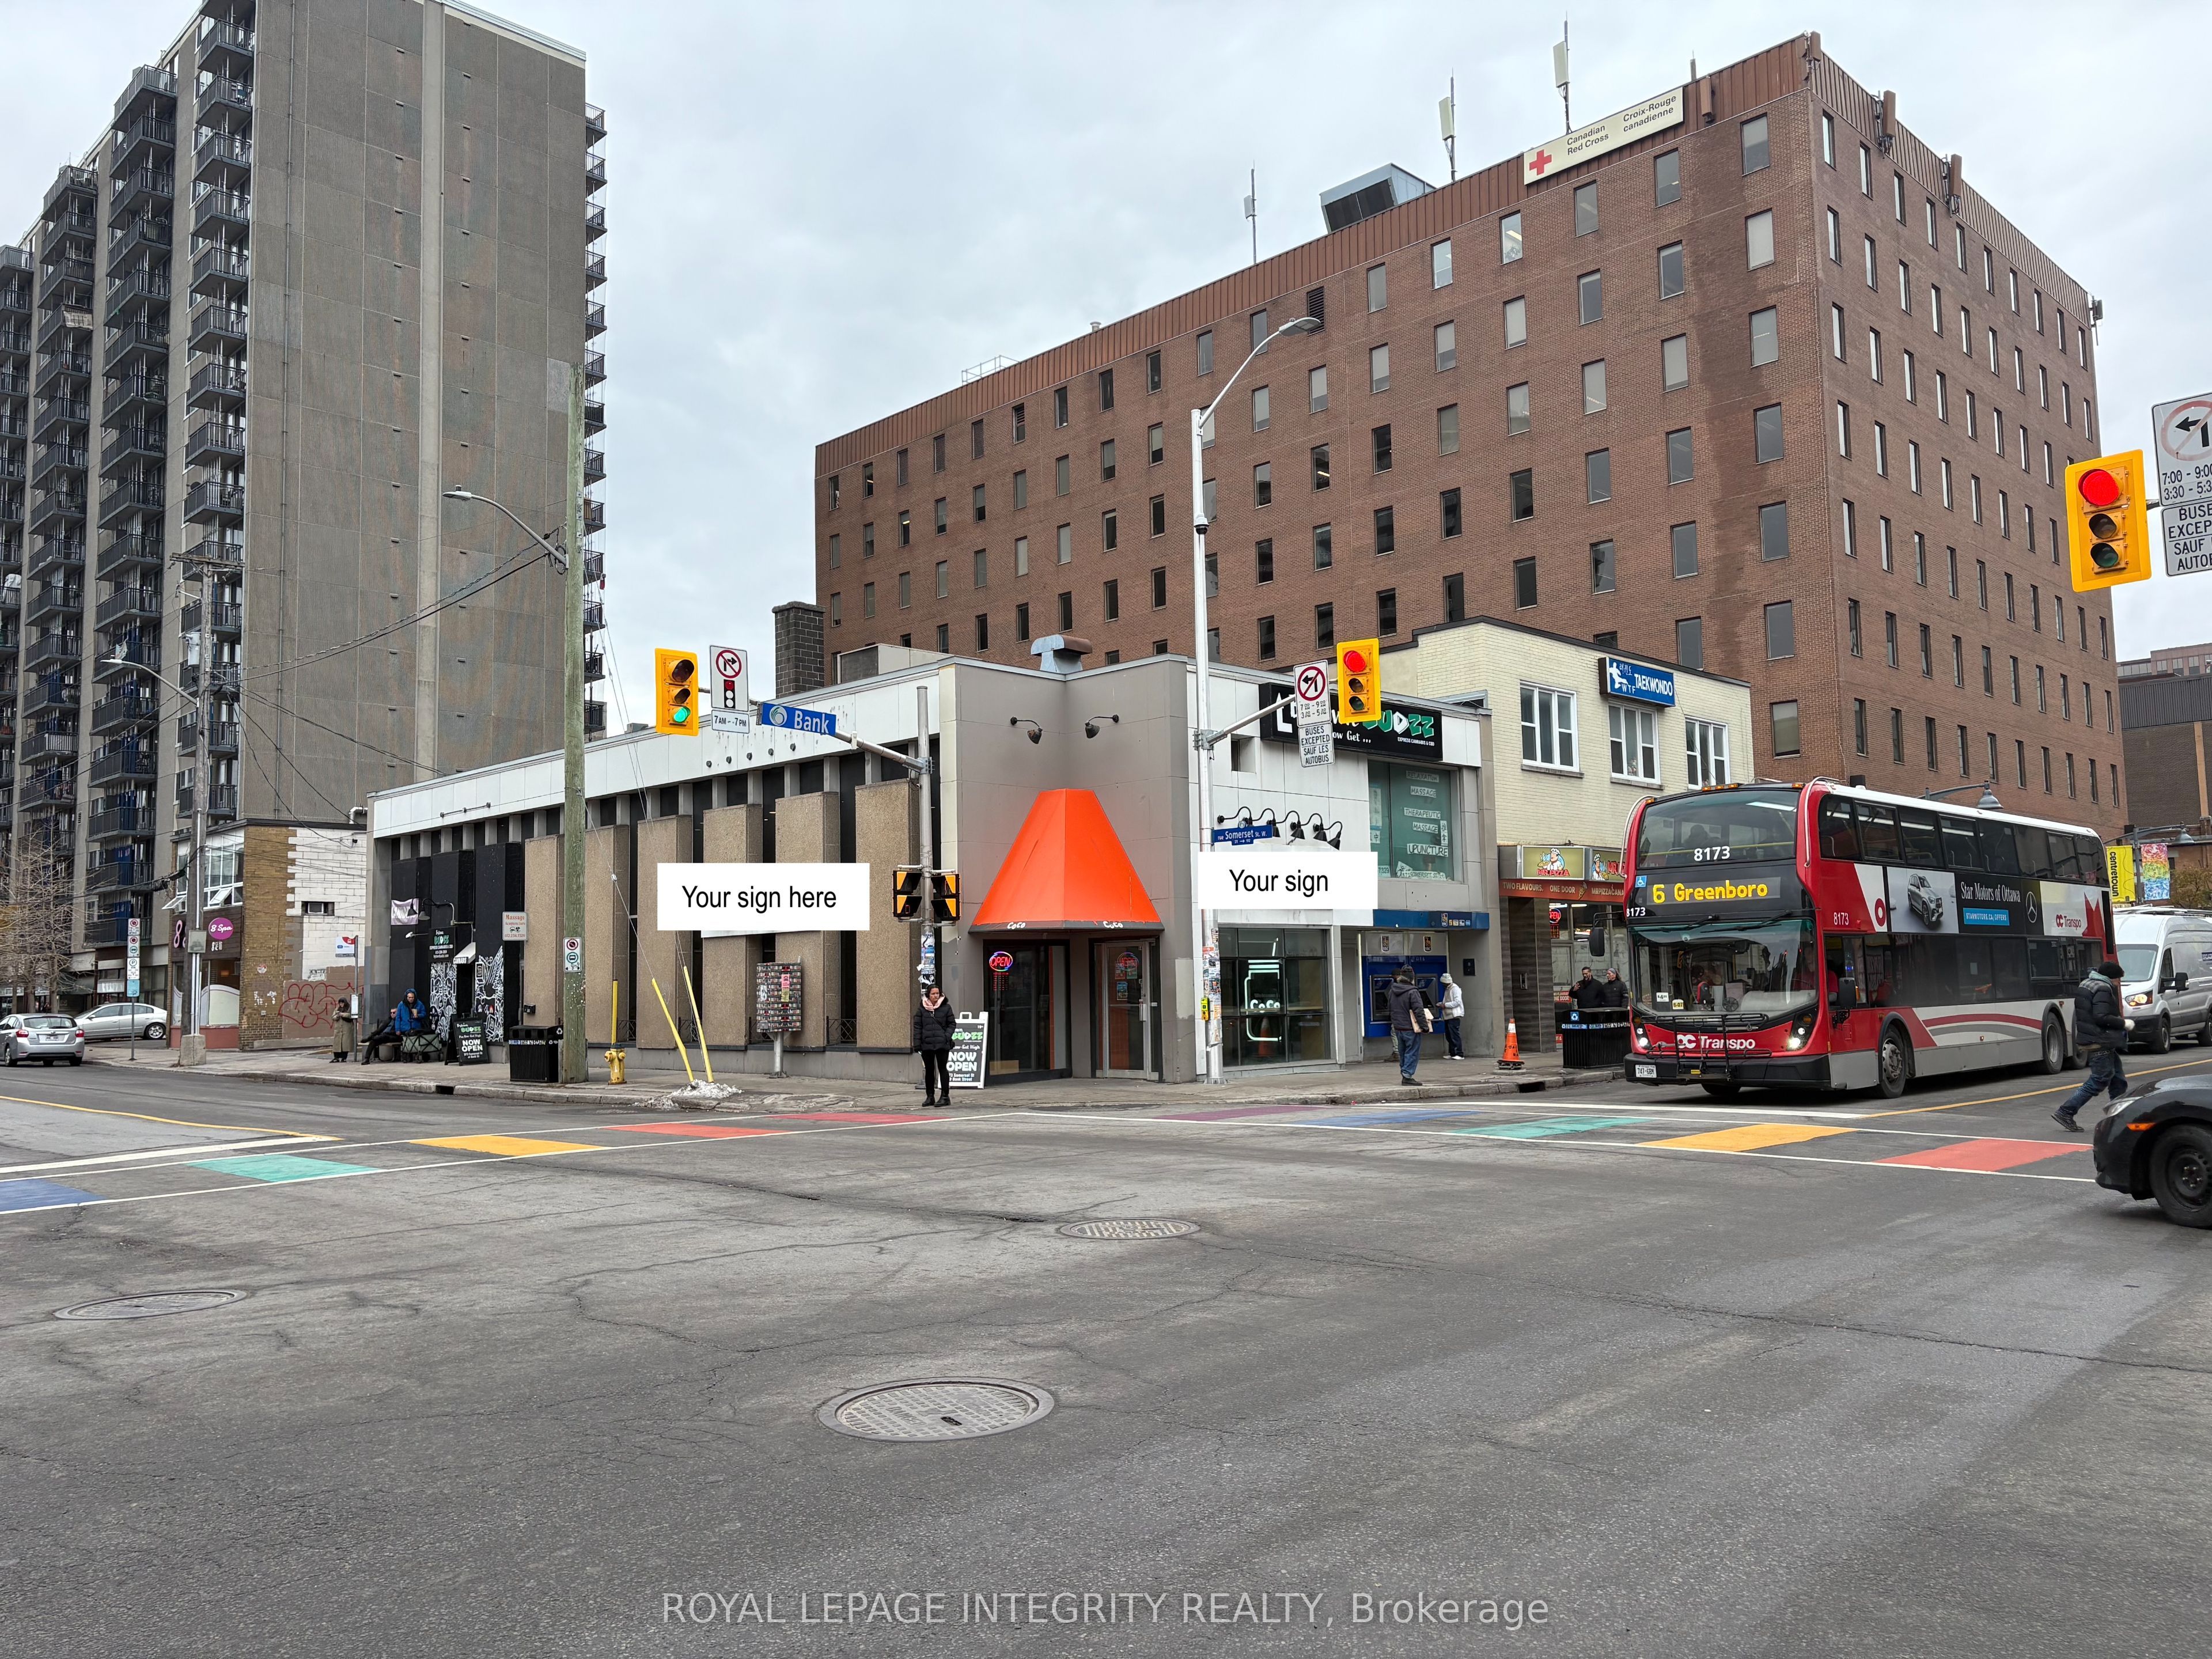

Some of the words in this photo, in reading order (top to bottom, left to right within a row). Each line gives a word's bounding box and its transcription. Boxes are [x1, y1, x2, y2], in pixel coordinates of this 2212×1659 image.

[1623, 96, 1676, 122] Croix-Rouge
[1623, 107, 1673, 132] canadienne
[1567, 125, 1605, 145] Canadian
[1567, 144, 1583, 156] Red
[1585, 134, 1609, 147] Cross
[2162, 470, 2183, 485] 7:00
[2164, 485, 2184, 500] 3:30
[2168, 520, 2212, 539] EXCEP
[2174, 538, 2205, 556] SAUF
[1622, 683, 1635, 694] WTF
[1634, 673, 1673, 696] TAEKWONDO
[794, 710, 830, 734] Bank
[1305, 726, 1324, 736] BUSES
[1332, 732, 1343, 740] ow
[1347, 730, 1361, 742] Get
[1301, 734, 1330, 746] EXCEPTED
[1304, 746, 1317, 756] SAUF
[1319, 745, 1329, 753] LES
[1305, 754, 1330, 764] AUTOBUS
[1411, 787, 1436, 797] MASSAGE
[1405, 808, 1440, 819] THERAPEUTIC
[1413, 823, 1438, 832] MASSAGE
[1225, 830, 1253, 839] Somerset
[1408, 844, 1448, 857] UPUNCTURE
[1694, 846, 1730, 861] 8173
[2109, 851, 2119, 897] centretown
[1516, 882, 1544, 892] FLAVOURS.
[1653, 884, 1665, 903] 6
[1674, 880, 1768, 902] Greenboro
[1961, 881, 1973, 899] Star
[1974, 882, 1994, 900] Motors
[1995, 884, 2001, 901] of
[2002, 885, 2021, 902] Ottawa
[1550, 911, 1560, 919] PEN
[1626, 907, 1646, 917] 8173
[1834, 912, 1849, 925] 8173
[210, 924, 216, 932] 8
[2064, 915, 2082, 930] Transpo
[990, 956, 1010, 967] OPEN
[1699, 1036, 1756, 1050] Transpo
[948, 1051, 977, 1061] NOW
[946, 1062, 978, 1071] OPEN
